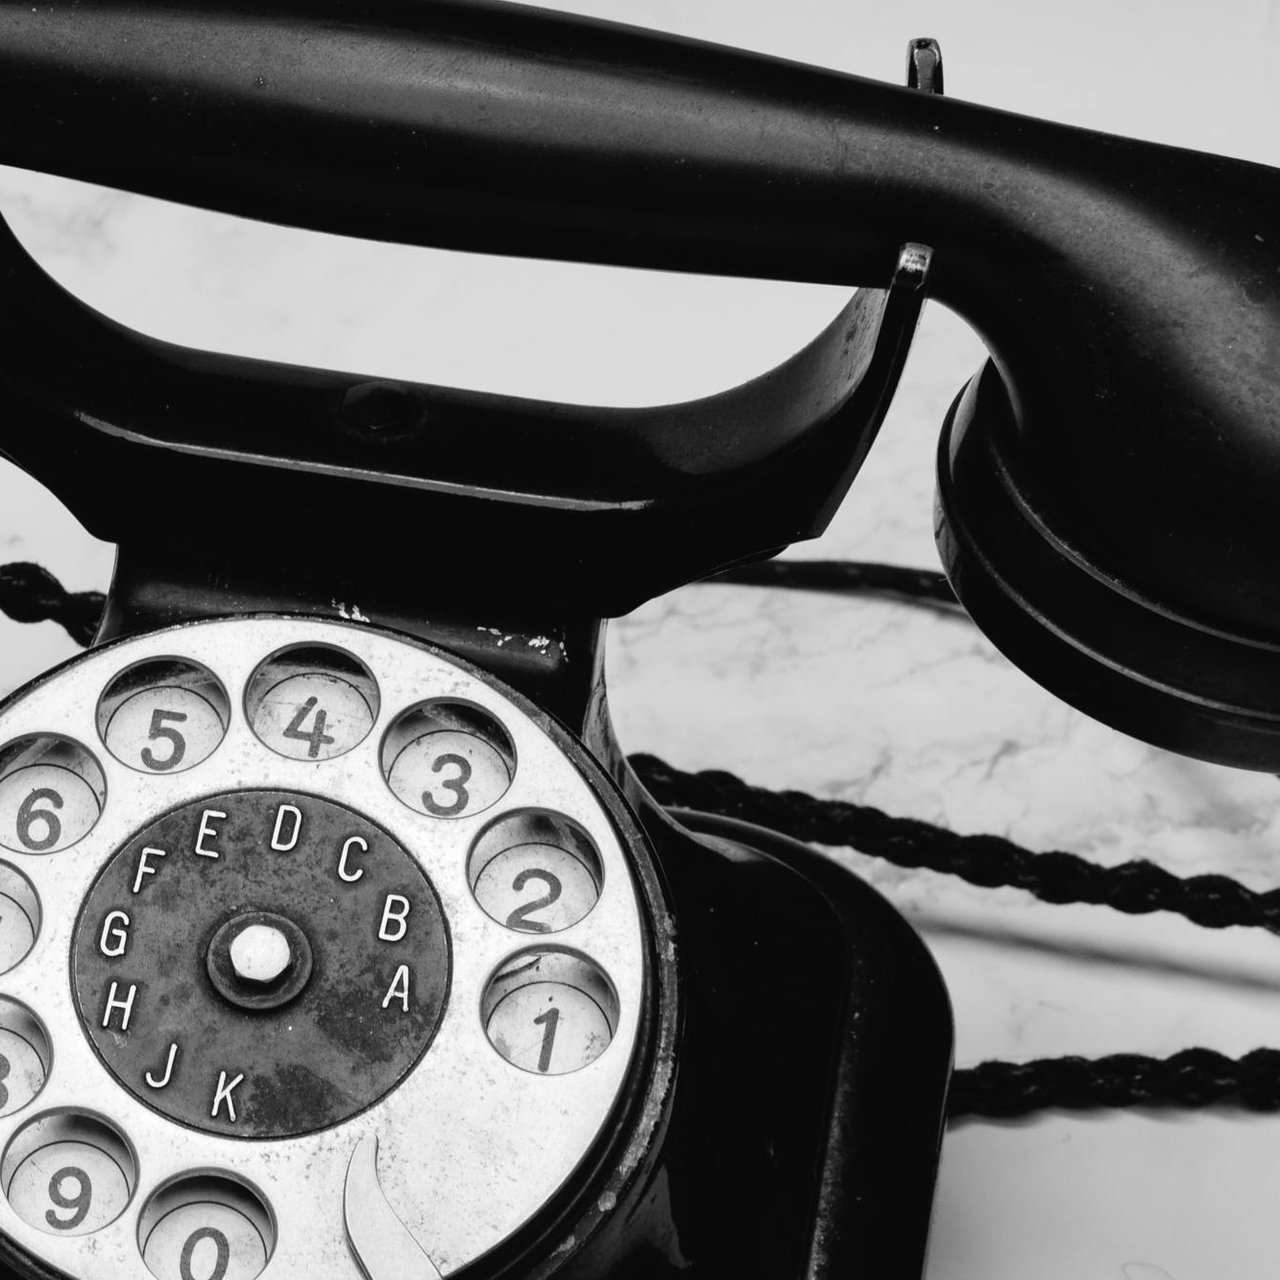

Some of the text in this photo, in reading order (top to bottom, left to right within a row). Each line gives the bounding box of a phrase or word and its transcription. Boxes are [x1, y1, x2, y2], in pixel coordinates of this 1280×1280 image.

[140, 709, 188, 771] 5
[283, 696, 335, 758] 4
[421, 753, 474, 816] 3
[15, 788, 62, 851] 6
[194, 810, 227, 857] E
[271, 805, 302, 851] D
[132, 847, 166, 892] F
[338, 837, 370, 882] C
[379, 894, 409, 942] B
[505, 868, 563, 933] 2
[99, 911, 130, 956] G
[103, 982, 136, 1030] H
[383, 965, 410, 1012] A
[534, 1007, 561, 1073] 1
[146, 1043, 177, 1089] J
[212, 1071, 243, 1122] K
[44, 1165, 93, 1230] 9
